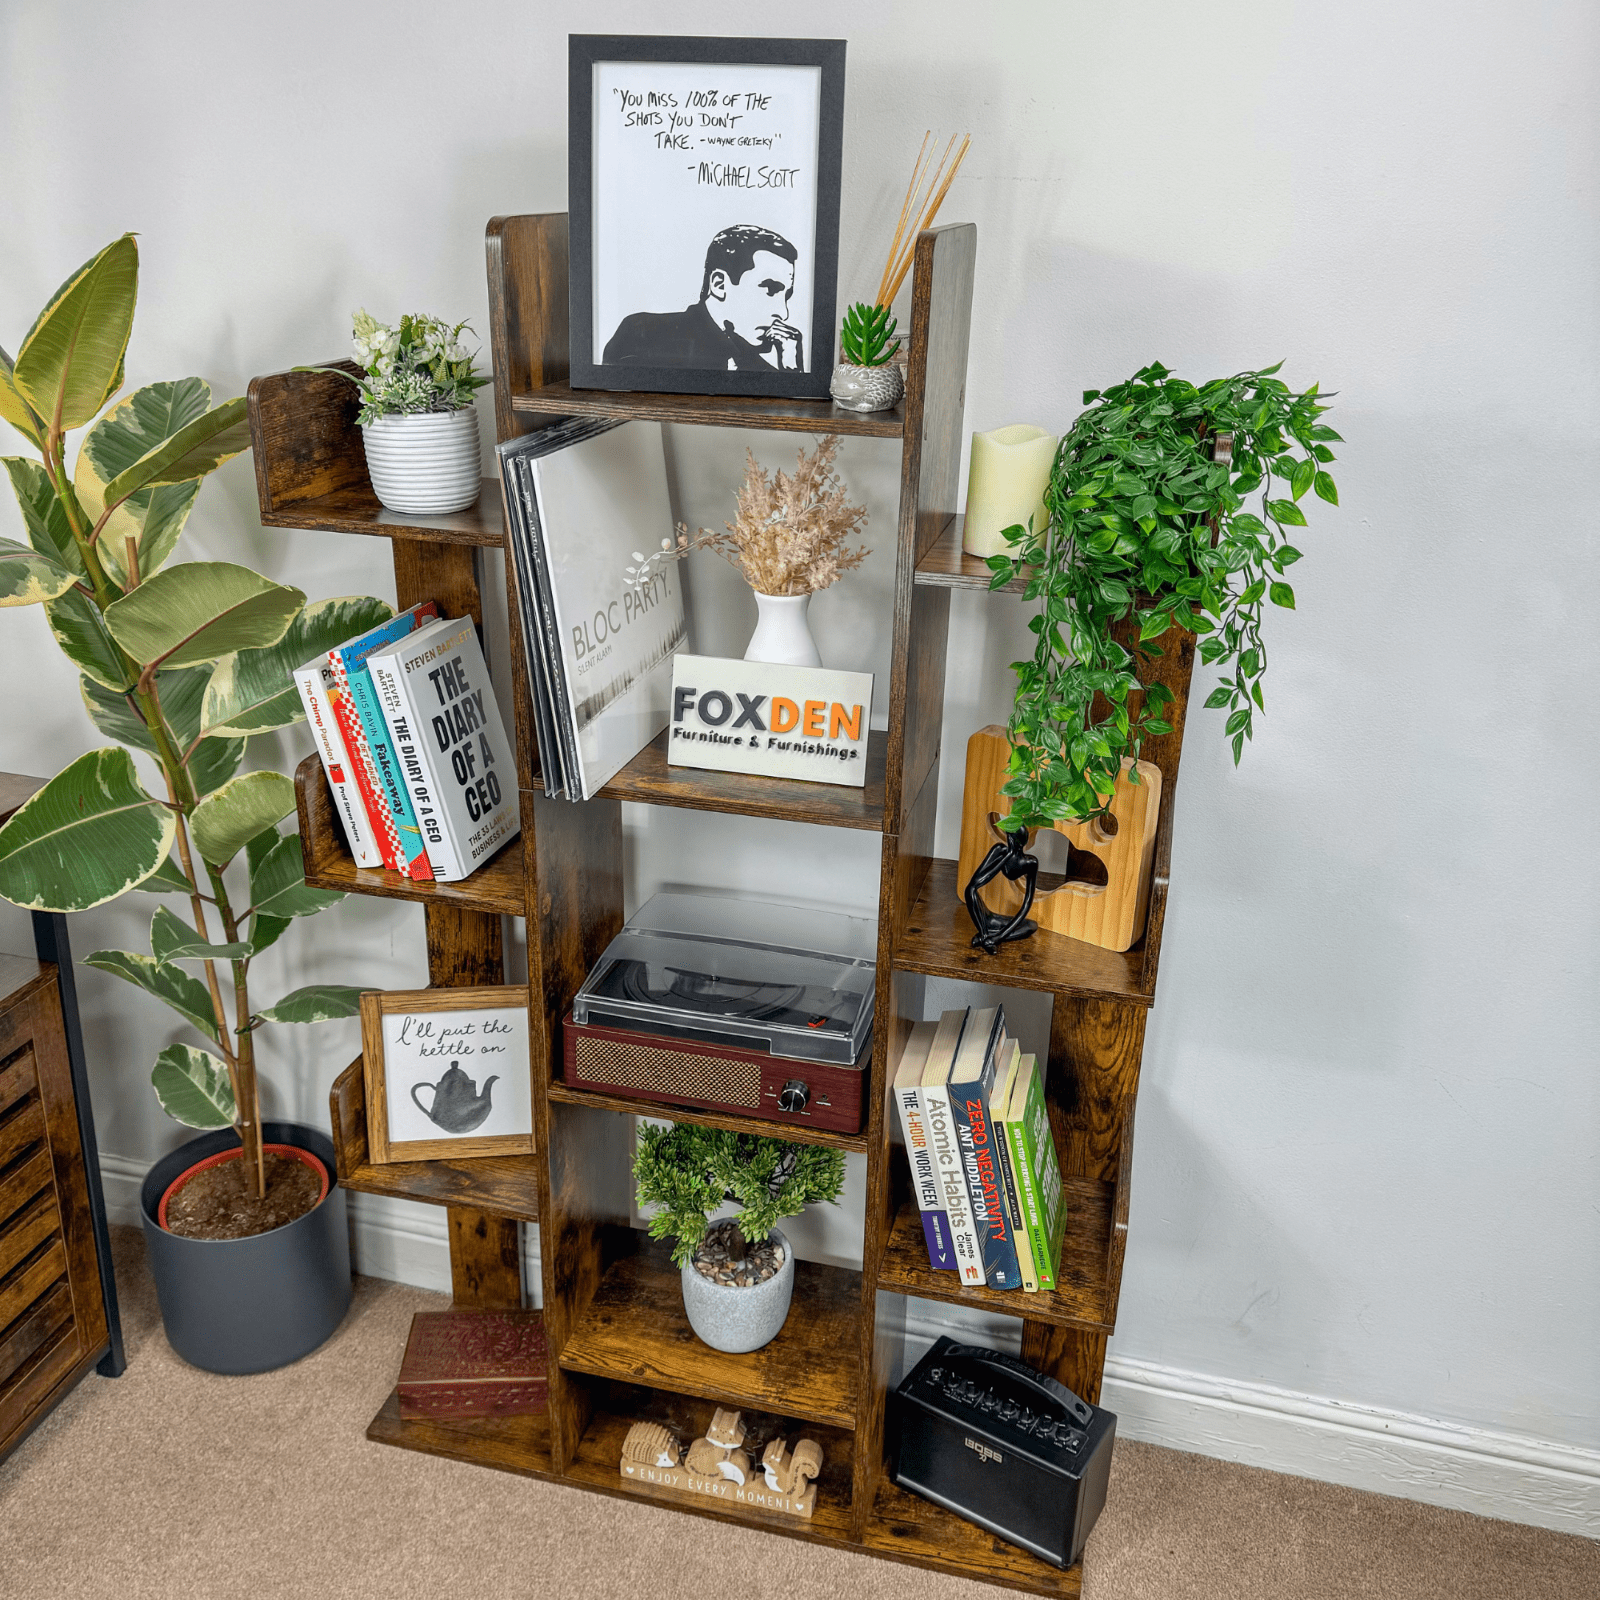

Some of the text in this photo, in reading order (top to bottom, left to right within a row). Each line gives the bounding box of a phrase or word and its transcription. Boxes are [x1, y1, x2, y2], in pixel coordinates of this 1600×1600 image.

[685, 90, 718, 108] 100%
[722, 93, 742, 108] OF
[745, 93, 772, 111] THE
[624, 111, 743, 133] SHOTS YOU DON'T
[654, 131, 694, 150] TAKE.
[757, 166, 800, 188] SCOTT
[572, 601, 621, 661] BLOC
[623, 567, 671, 624] PARTY.
[404, 648, 437, 674] STEVEN
[436, 628, 473, 656] BARTLETT
[578, 644, 612, 676] SILENT ALARM
[376, 669, 396, 713] BARTLETT
[385, 673, 402, 707] STEVEN
[428, 656, 470, 706] THE
[303, 679, 335, 761] The Chimp Paradox
[354, 683, 369, 709] CHRIS
[365, 711, 378, 737] BAVIN
[431, 688, 488, 754] DIARY
[673, 686, 863, 741] FOXDEN
[359, 743, 378, 786] GET BAKED
[451, 732, 495, 786] OF A
[673, 727, 858, 760] Furniture & Furnishings
[374, 743, 406, 816] Fakeaway
[393, 716, 442, 842] THE DIARY OF A CEO
[465, 770, 502, 822] CEO
[339, 786, 360, 842] Prof Steve Peters
[468, 831, 482, 846] THE
[481, 825, 490, 837] 33
[471, 830, 501, 860] BUSINESS
[395, 1016, 513, 1046] I'll put the
[419, 1040, 507, 1057] kettle on
[902, 1091, 939, 1207] THE 4-HOUR WORK WEEK
[926, 1097, 967, 1228] Atomic Habits
[966, 1098, 1007, 1241] ZERO NEGATIVITY
[1018, 1147, 1026, 1161] STOP
[958, 1123, 989, 1221] ANT MIDDLETON
[1026, 1192, 1035, 1208] START
[1029, 1208, 1038, 1226] LIVING
[956, 1234, 966, 1258] Clear
[964, 1232, 975, 1259] James
[1037, 1243, 1047, 1270] CARNEGIE
[965, 1437, 1003, 1464] BOSS
[640, 1468, 790, 1510] ENJOY EVERY MOMENT
